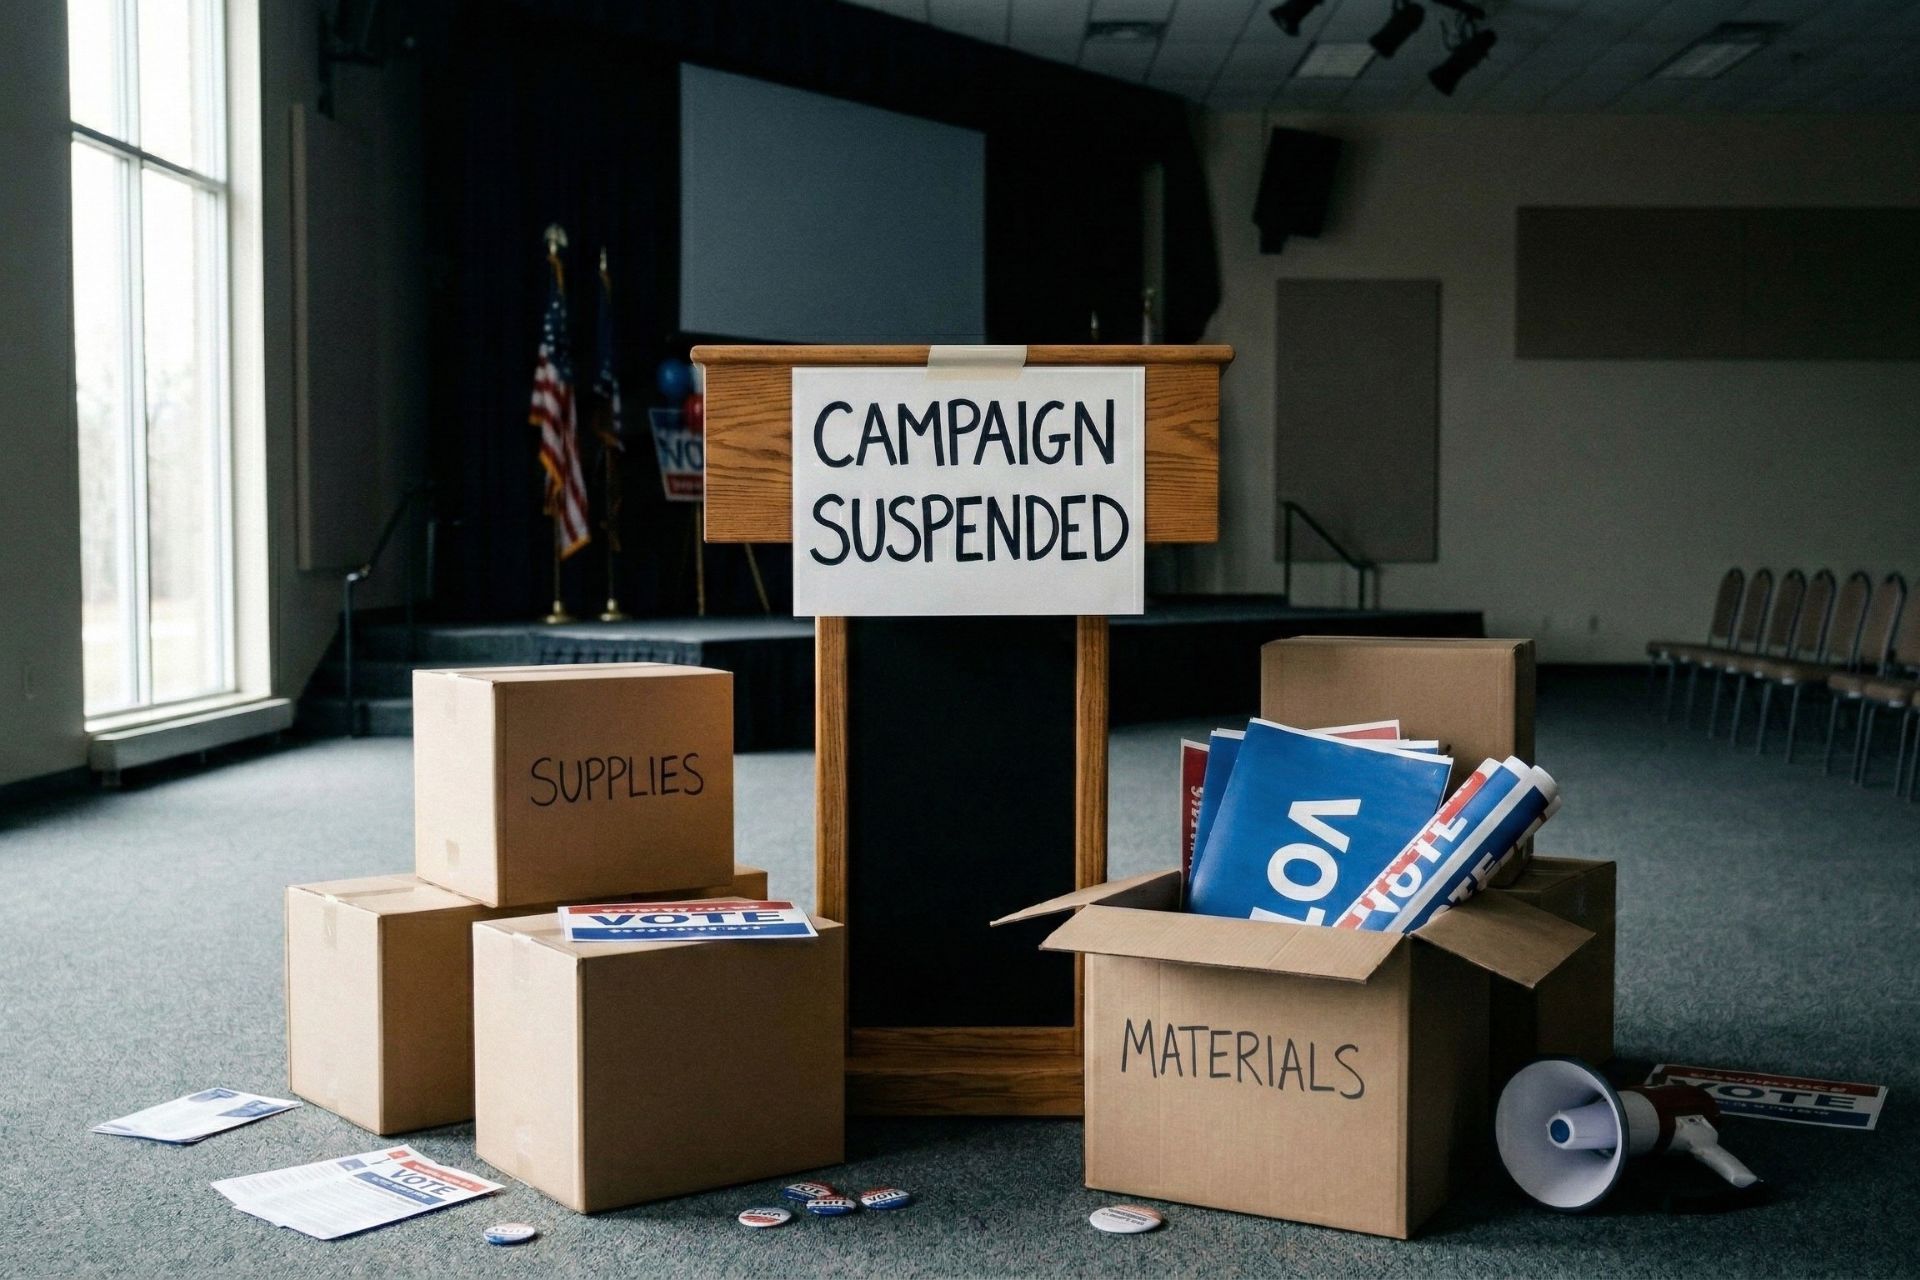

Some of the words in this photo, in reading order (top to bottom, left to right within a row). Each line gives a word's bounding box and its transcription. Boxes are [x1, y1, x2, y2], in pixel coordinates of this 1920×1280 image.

[813, 398, 1115, 468] CAMPAIGN
[809, 493, 1130, 566] SUSPENDED
[530, 752, 704, 807] SUPPLIES
[589, 911, 785, 926] VOTE
[1121, 1018, 1366, 1100] MATERIALS
[390, 1169, 459, 1196] VOTE
